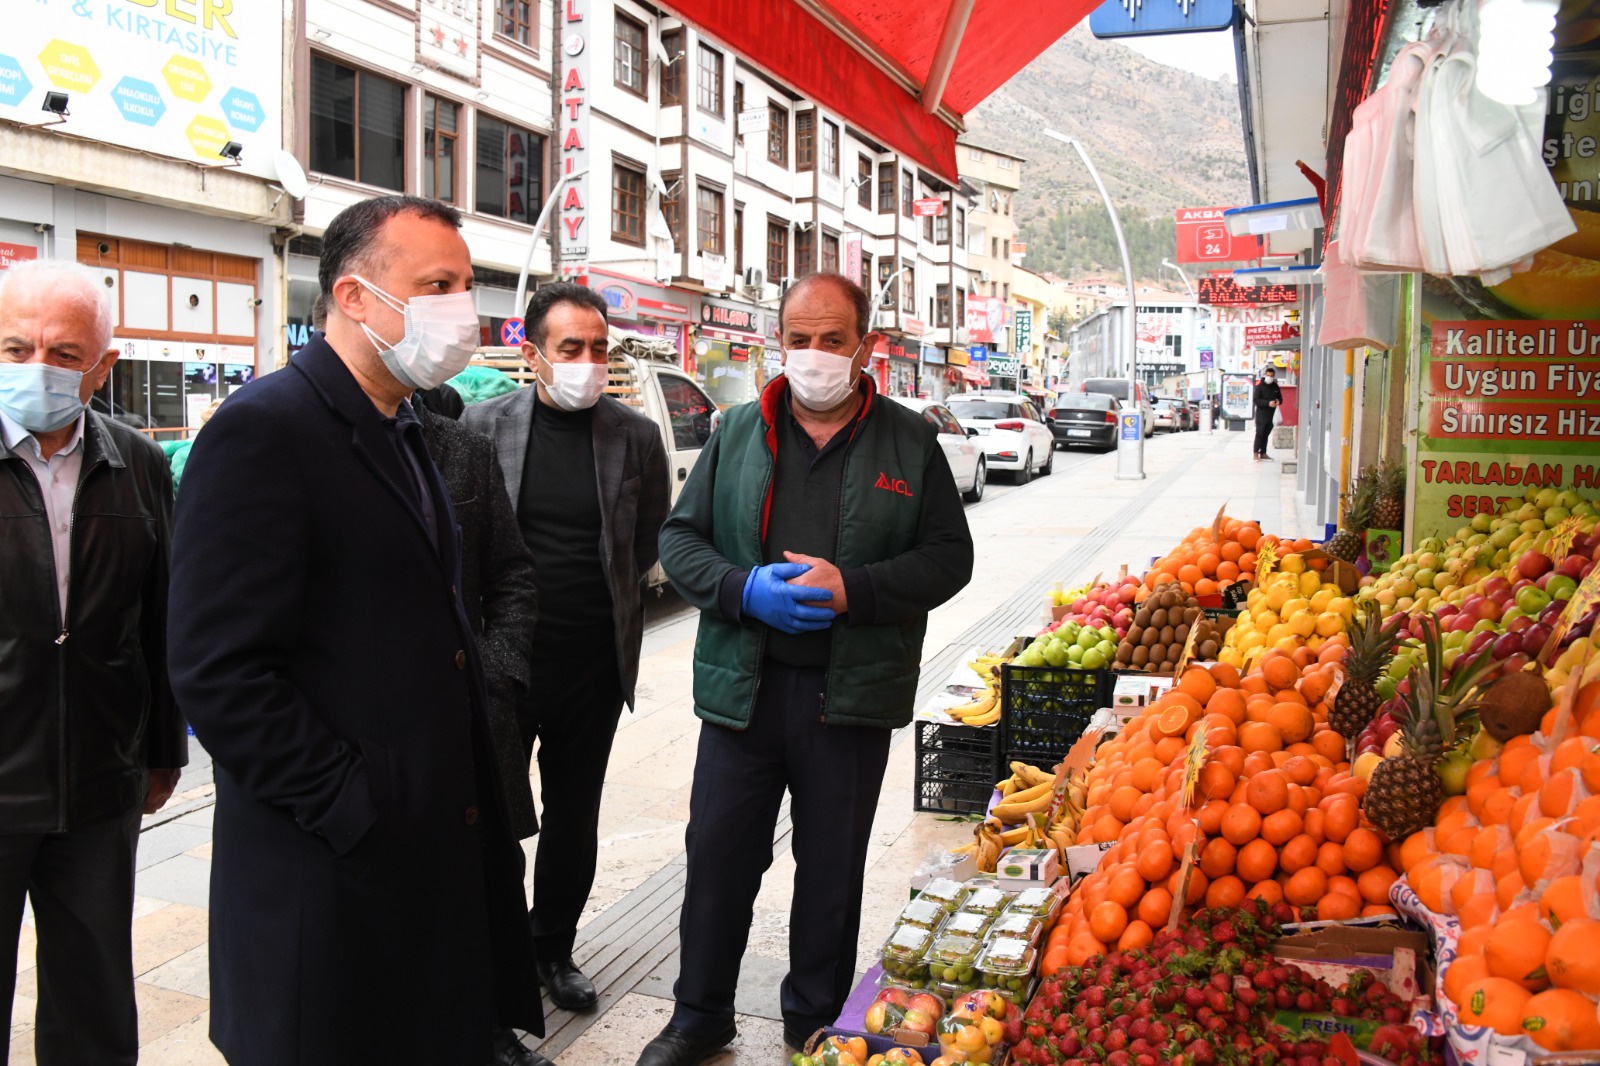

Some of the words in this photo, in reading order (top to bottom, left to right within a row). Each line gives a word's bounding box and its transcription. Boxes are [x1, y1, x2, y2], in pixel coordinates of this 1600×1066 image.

[106, 4, 238, 67] KIRTASİYE
[116, 85, 161, 106] ANAOKULU
[122, 99, 156, 118] İLKOKUL
[1205, 244, 1221, 255] 24
[1445, 328, 1556, 356] Kaliteli
[1444, 364, 1536, 396] Uygun
[1440, 406, 1548, 435] Sınırsız
[1421, 459, 1563, 488] TARLADAN
[1302, 1018, 1355, 1036] FRESH
